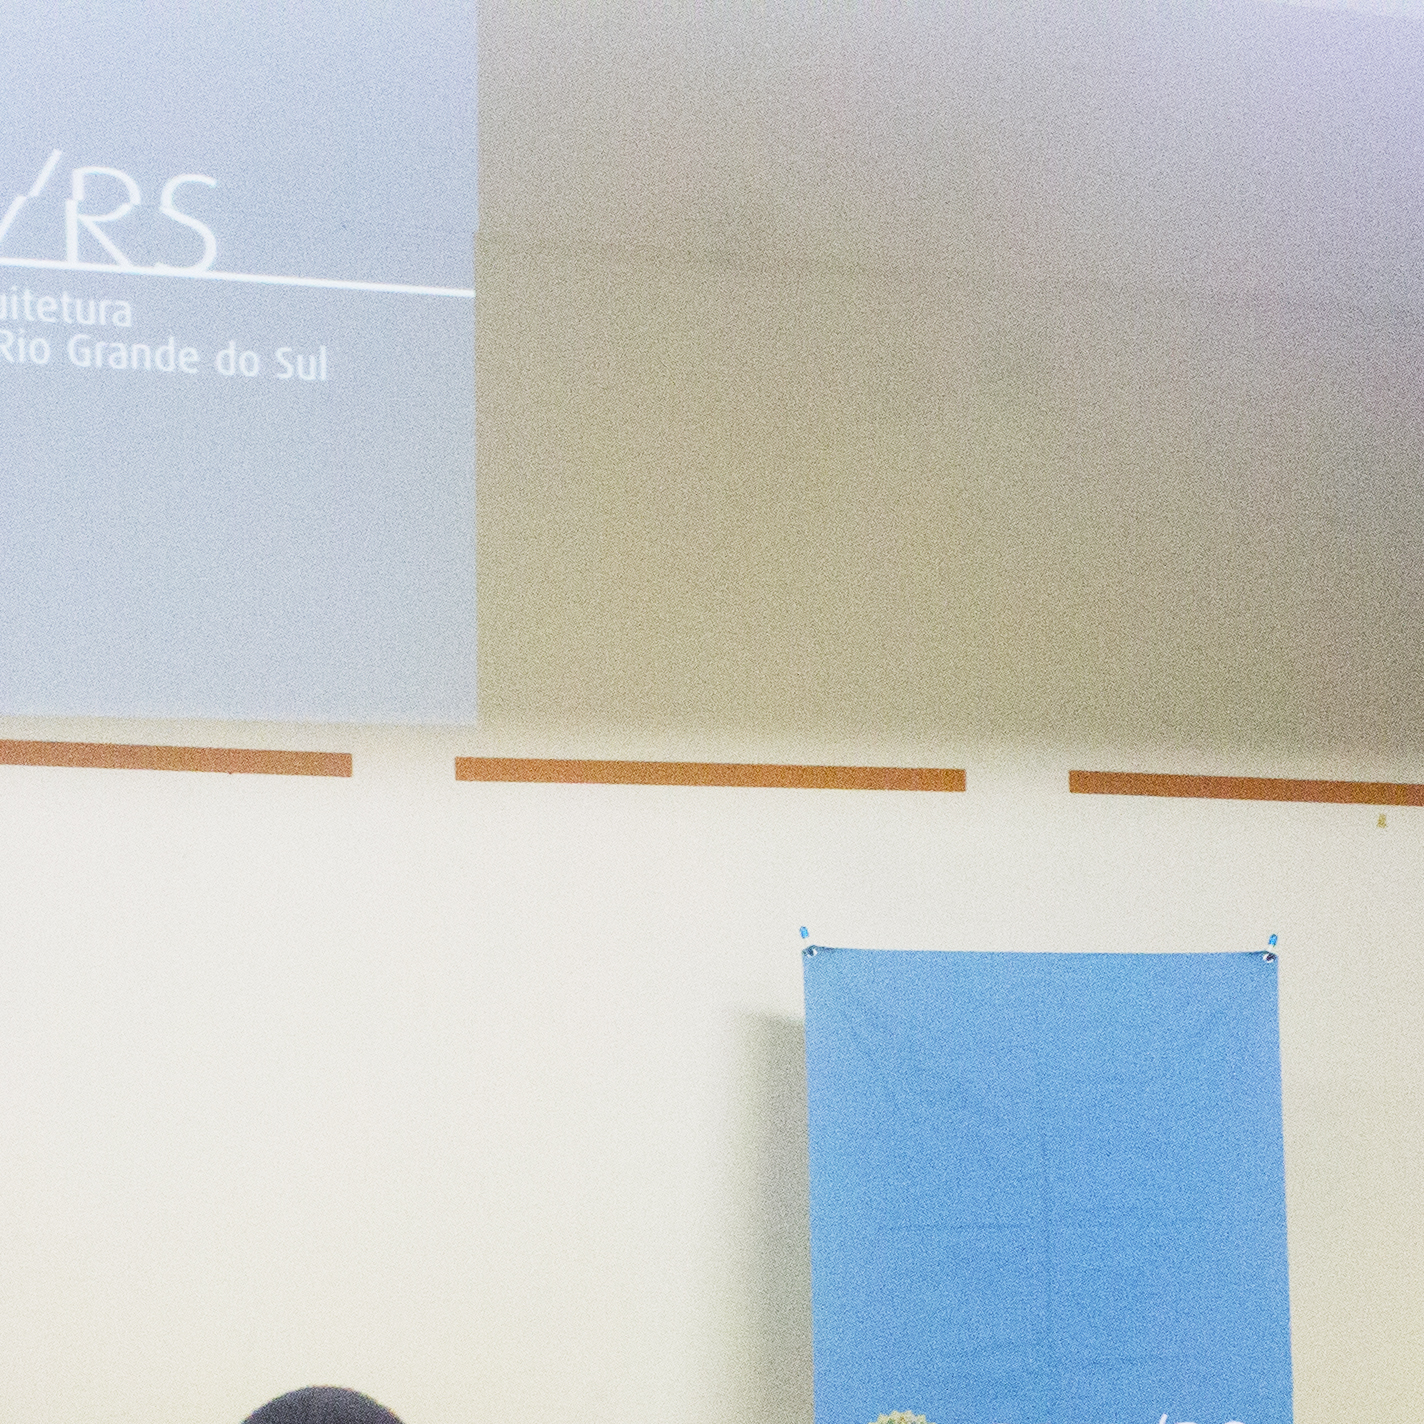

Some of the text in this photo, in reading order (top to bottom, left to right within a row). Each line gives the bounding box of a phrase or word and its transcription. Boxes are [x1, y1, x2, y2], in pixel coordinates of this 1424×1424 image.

[68, 333, 200, 374] Grande
[216, 339, 259, 378] do
[276, 344, 327, 381] Sul
